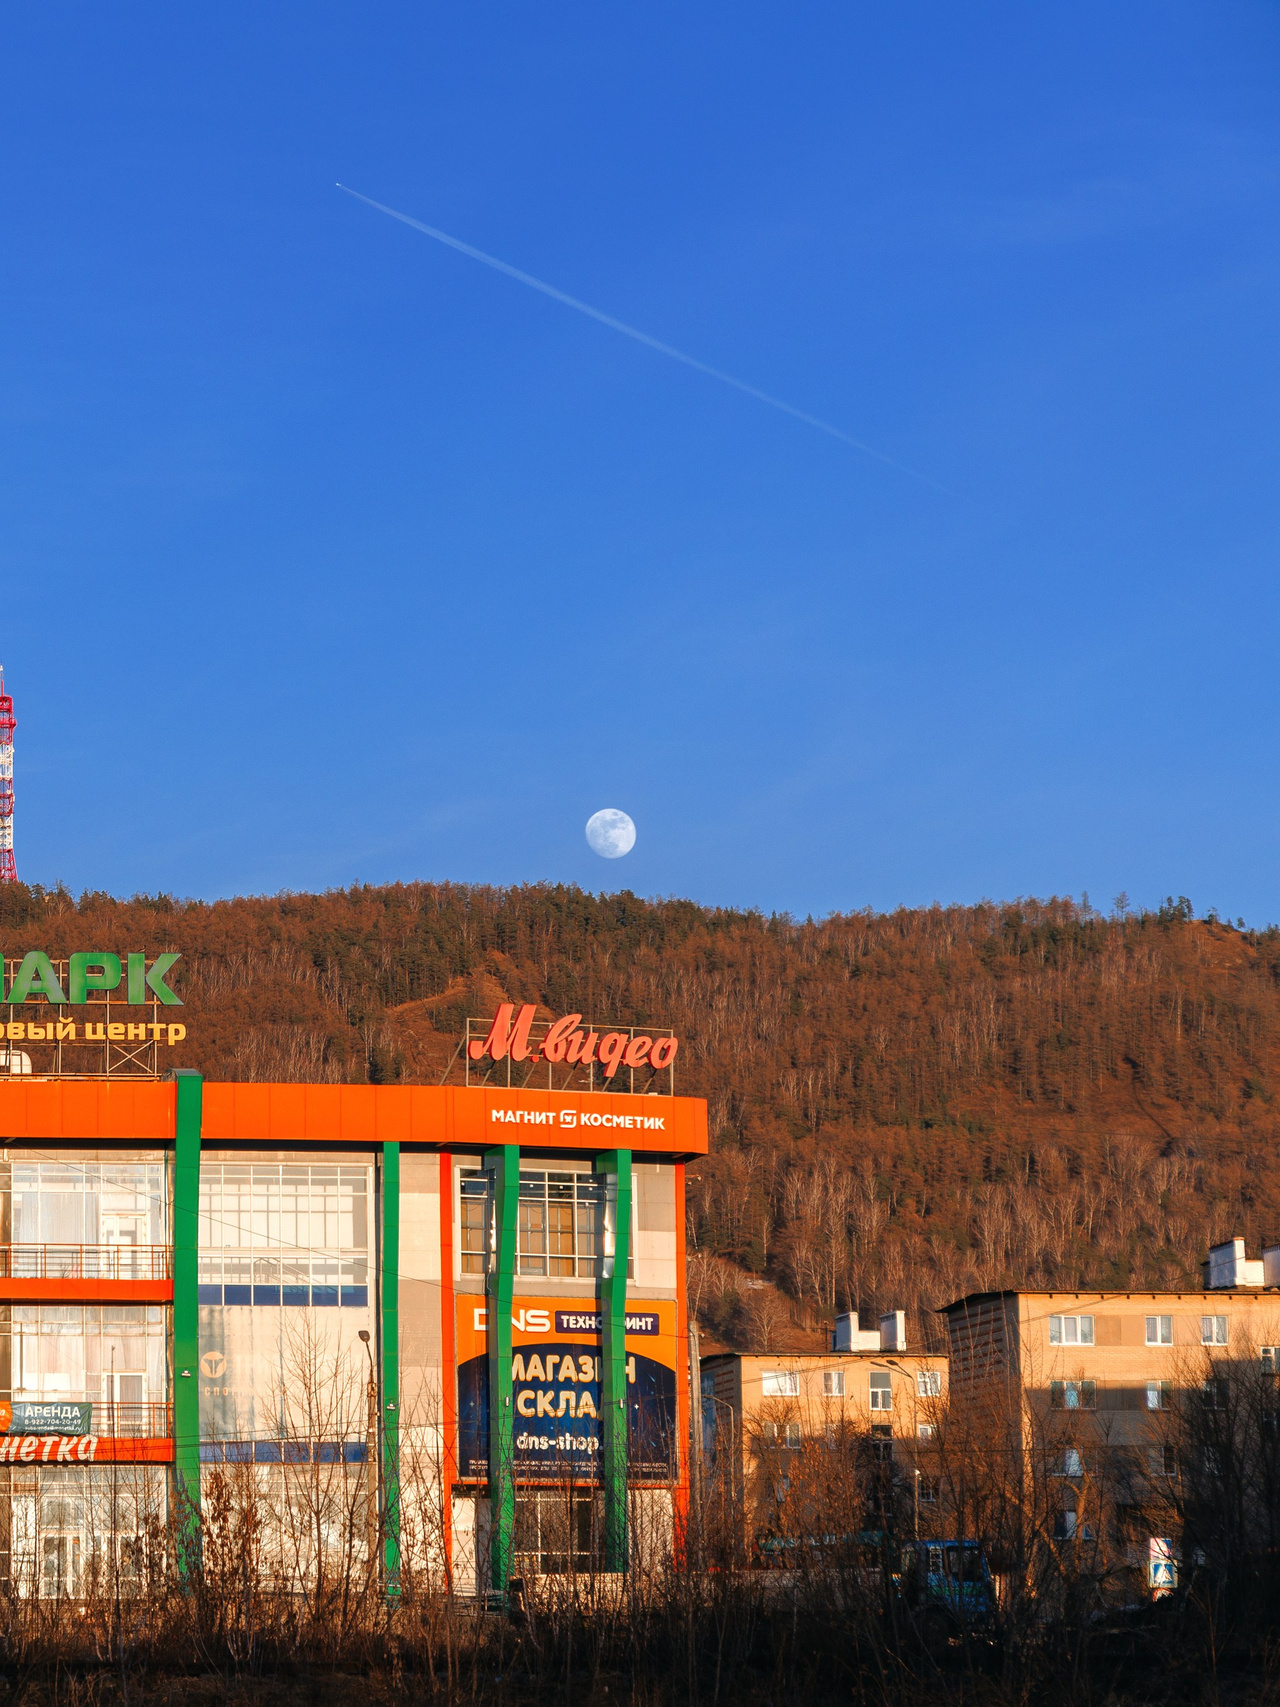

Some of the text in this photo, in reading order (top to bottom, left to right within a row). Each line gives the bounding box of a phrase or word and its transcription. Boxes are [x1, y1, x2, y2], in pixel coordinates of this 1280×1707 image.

[84, 1021, 188, 1046] центр
[491, 1109, 666, 1130] МАГНИТ КОСМЕТИК
[24, 1406, 81, 1420] АРЕНДА
[517, 1389, 602, 1420] СКЛА
